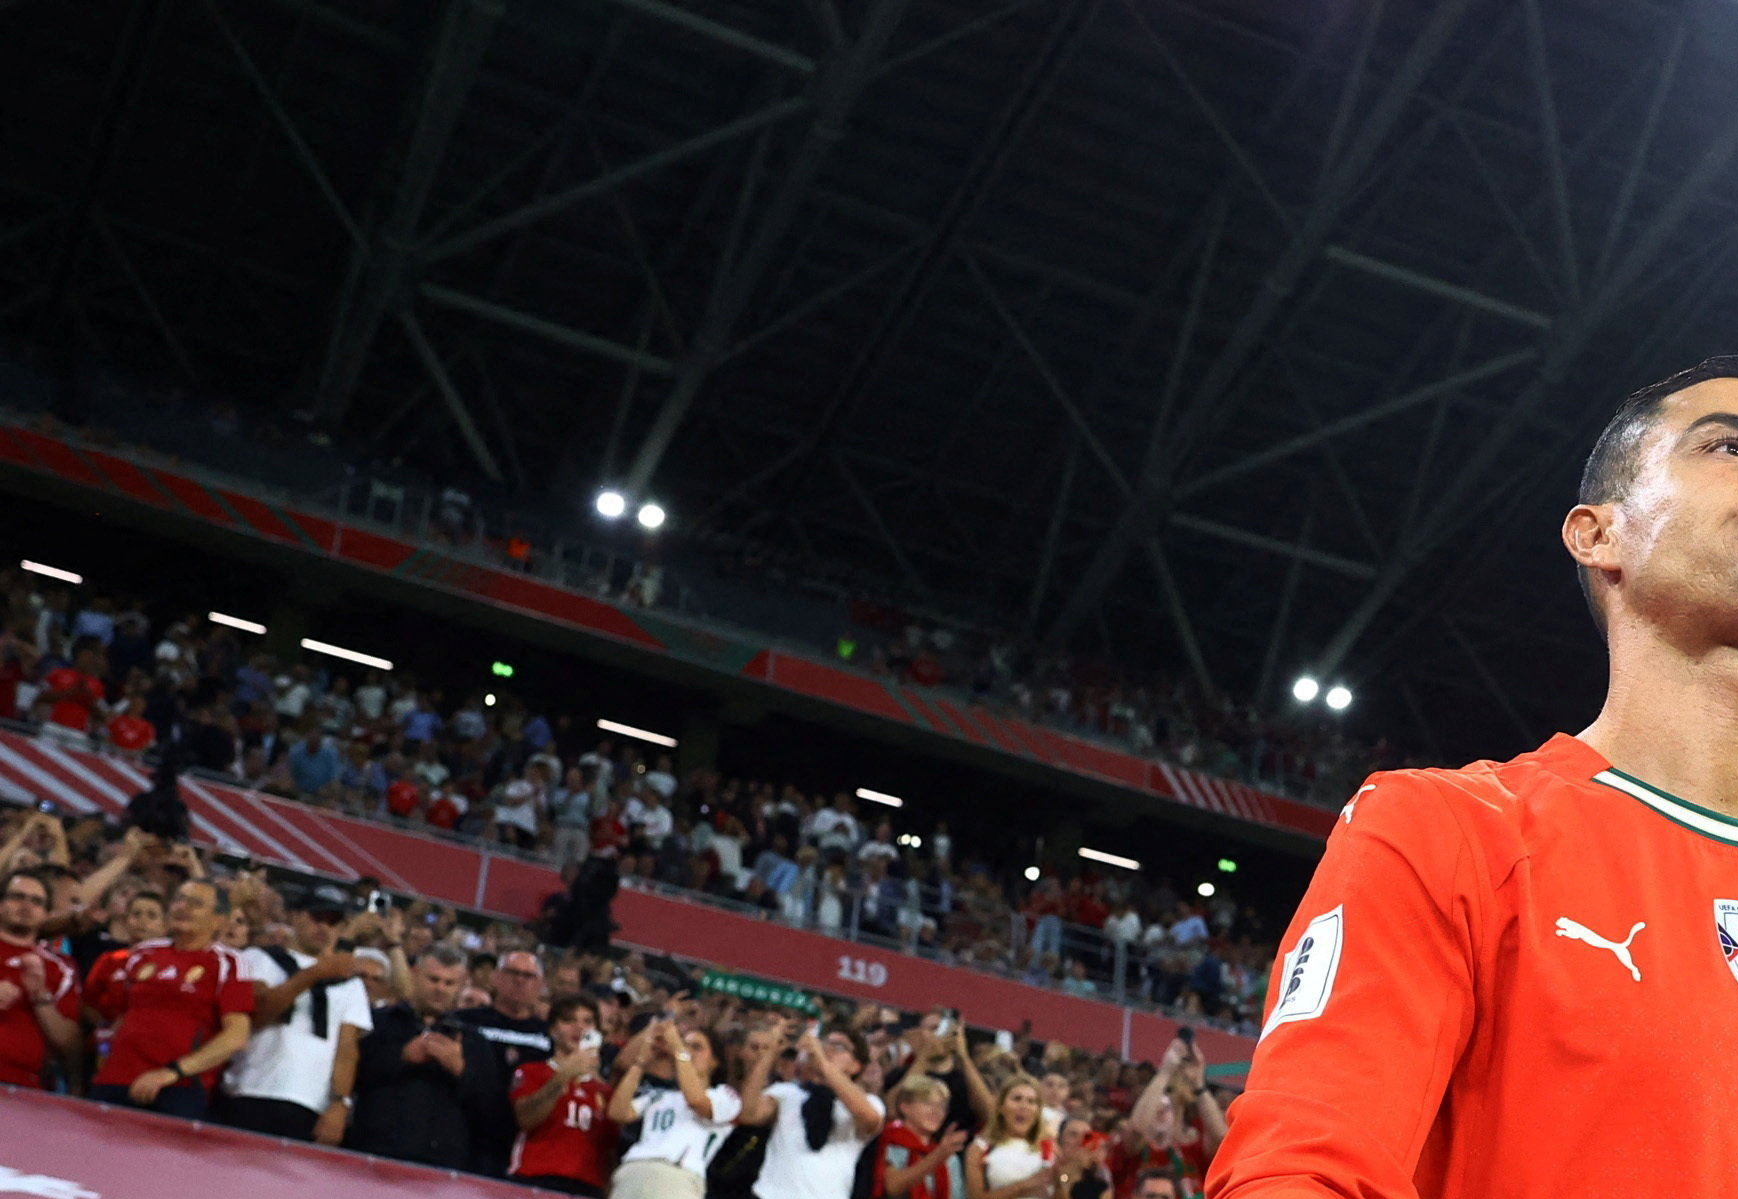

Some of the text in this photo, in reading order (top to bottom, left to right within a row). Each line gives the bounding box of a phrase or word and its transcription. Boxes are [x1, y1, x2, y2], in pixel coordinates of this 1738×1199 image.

[837, 956, 888, 988] 119
[564, 1100, 593, 1132] 10
[651, 1108, 677, 1133] 10
